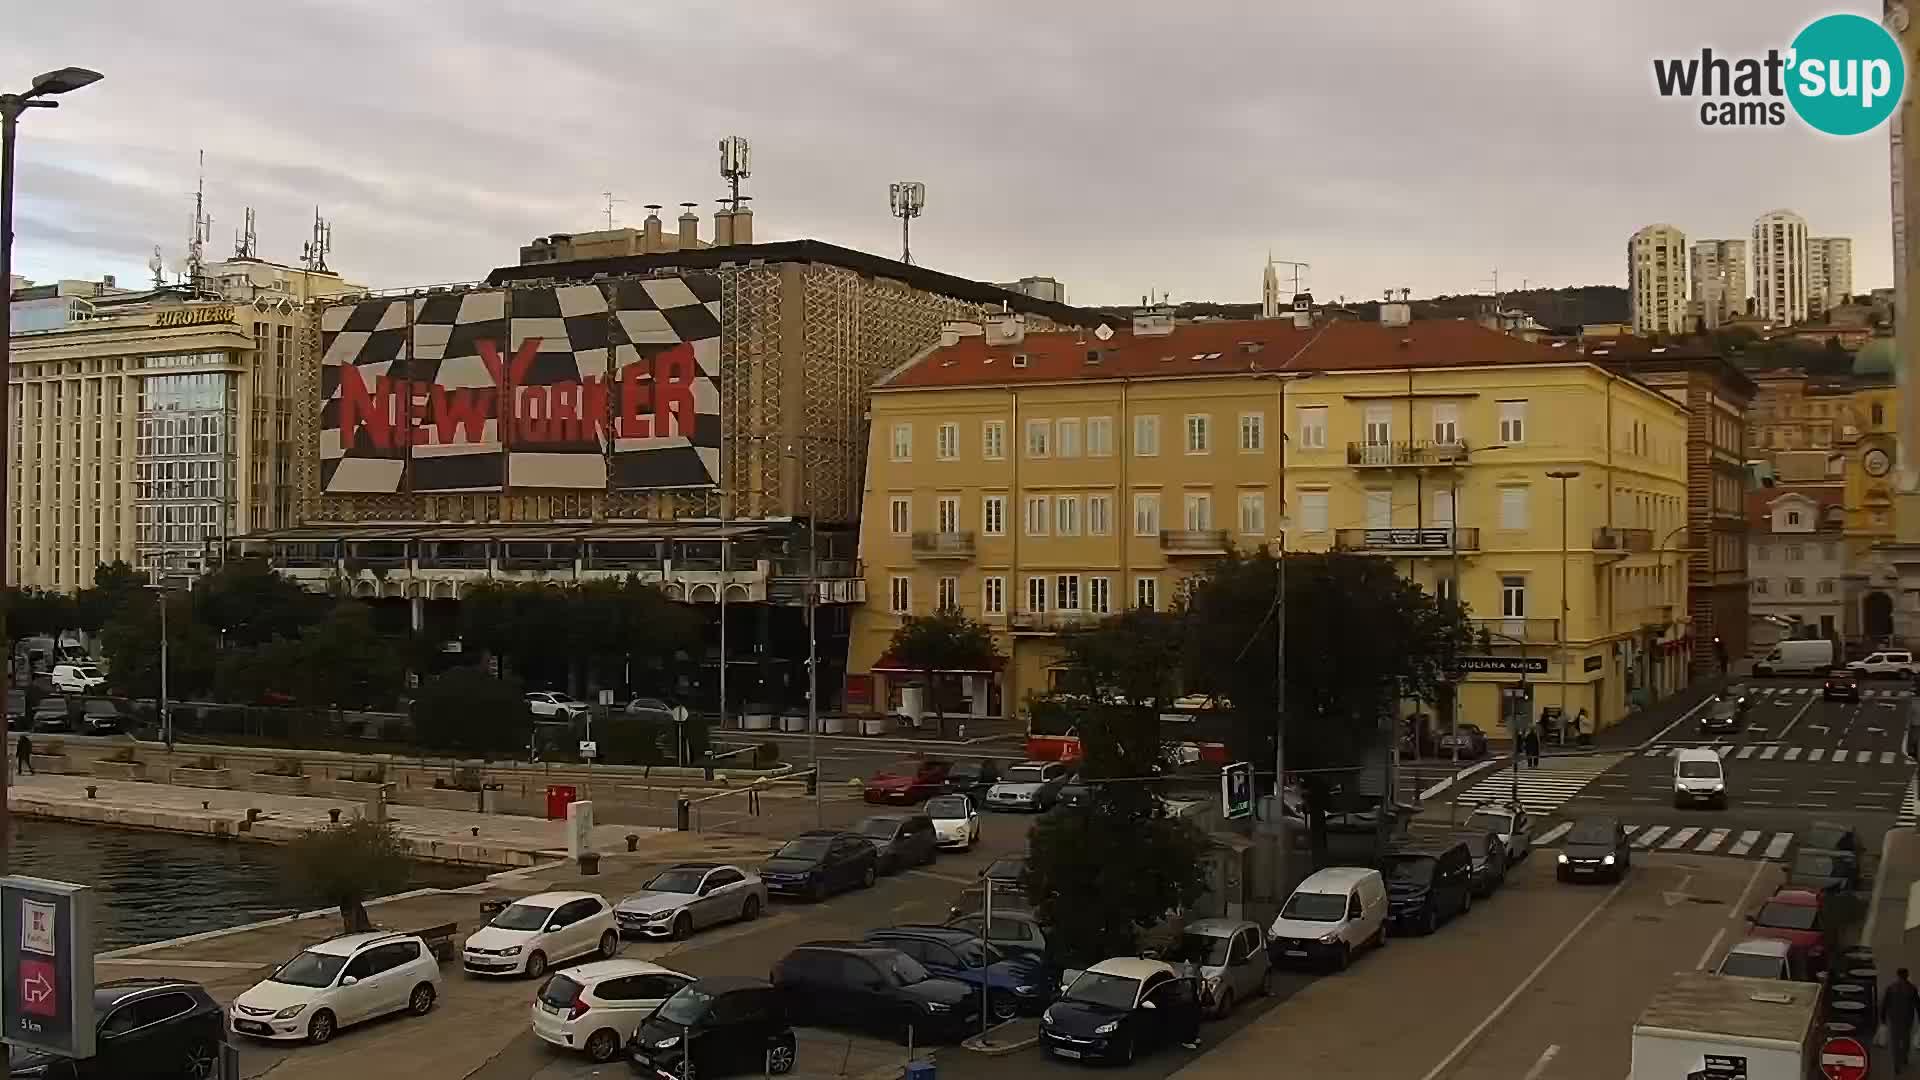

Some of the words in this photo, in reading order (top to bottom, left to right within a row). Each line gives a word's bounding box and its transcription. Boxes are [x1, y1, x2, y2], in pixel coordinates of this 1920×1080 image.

[339, 361, 495, 449] NEW
[474, 336, 696, 443] YORKER
[1460, 661, 1506, 670] JULIANA
[1510, 661, 1542, 670] NAILS
[21, 1018, 27, 1030] 5
[28, 1018, 42, 1032] km
